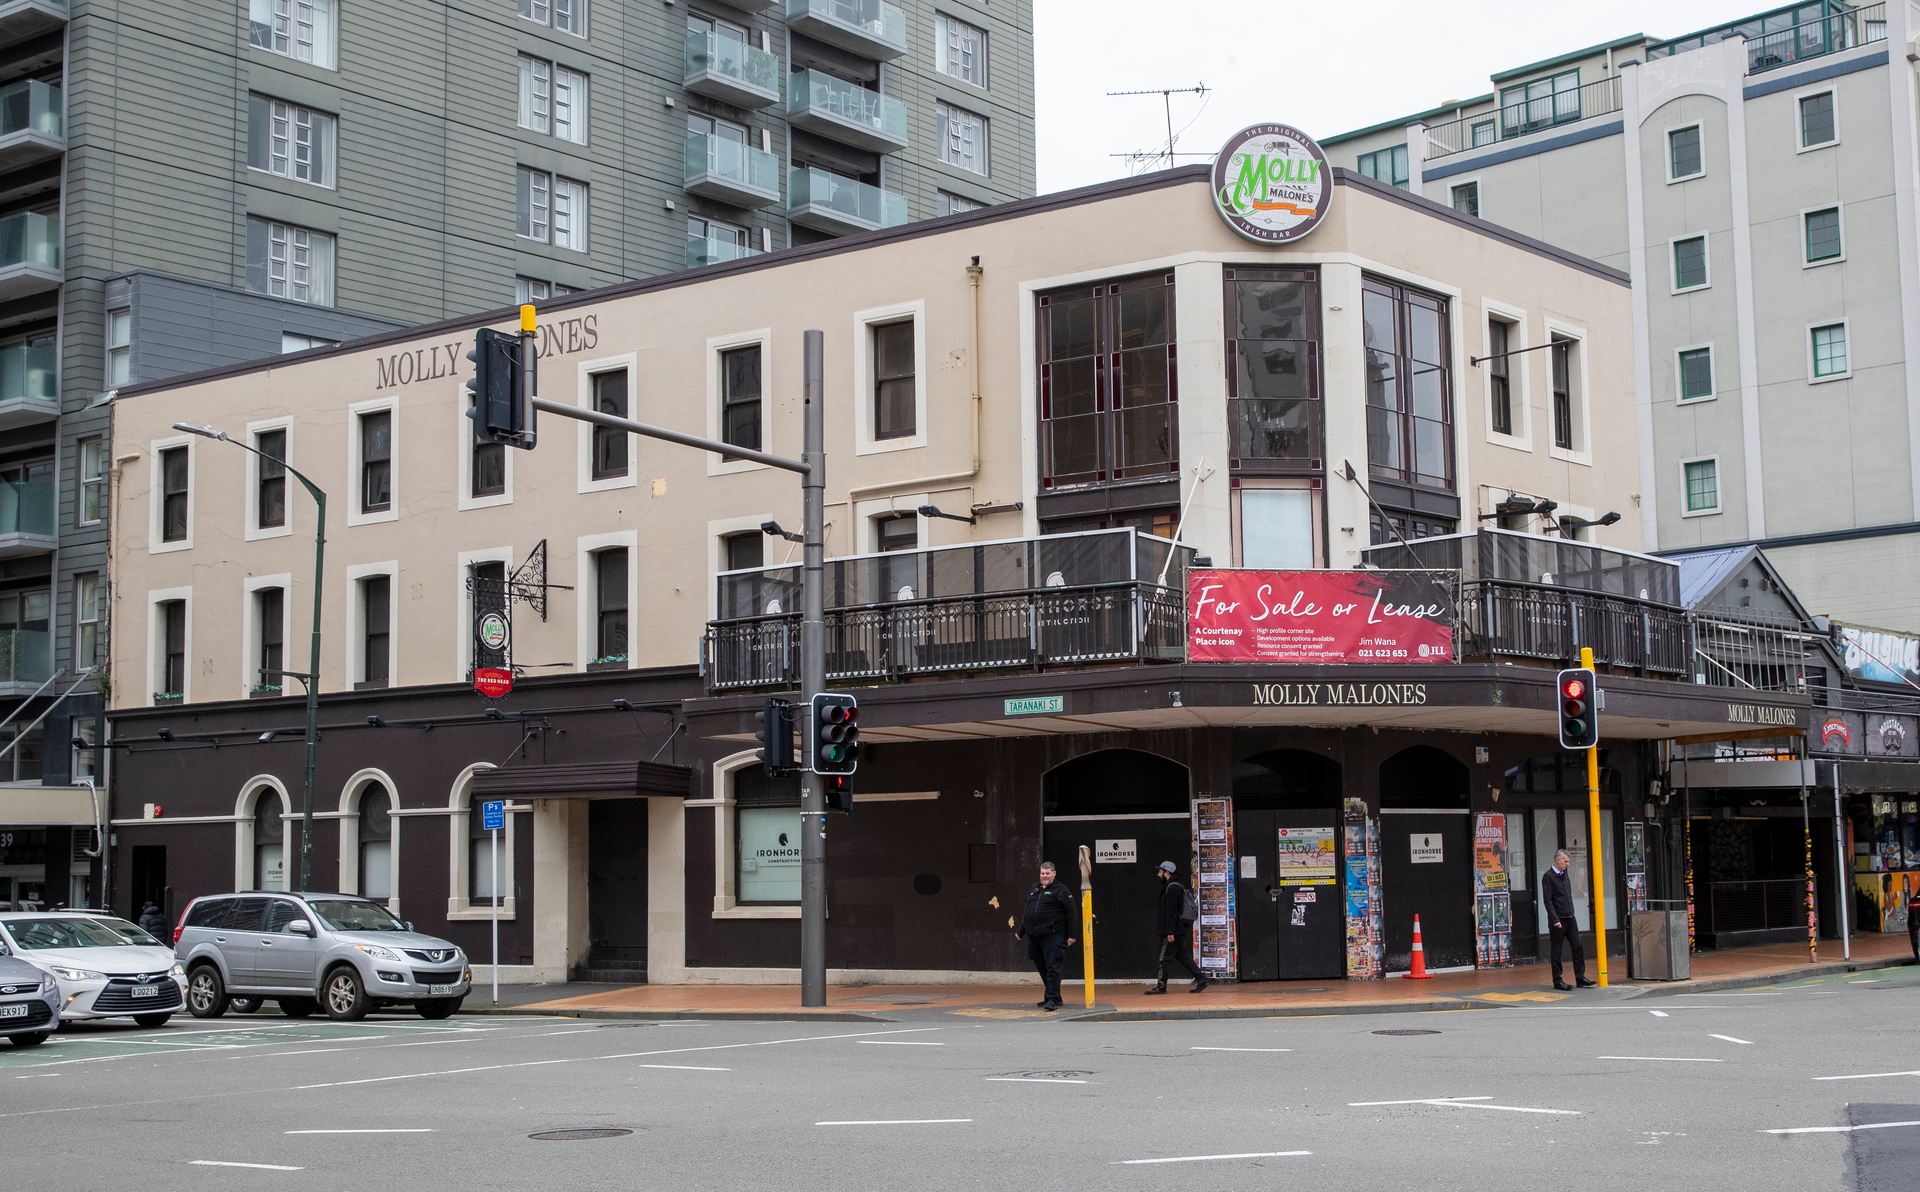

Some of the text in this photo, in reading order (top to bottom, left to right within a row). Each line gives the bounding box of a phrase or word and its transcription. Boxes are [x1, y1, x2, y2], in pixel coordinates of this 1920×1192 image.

[1245, 126, 1311, 148] THE ORIGINAL
[1222, 153, 1323, 214] MOLLY
[1269, 186, 1315, 203] MALONE'S
[1240, 221, 1291, 239] IRISH BAR
[376, 341, 463, 390] MOLLY
[1195, 584, 1241, 620] For
[1250, 583, 1323, 621] Sale
[1332, 603, 1358, 617] or
[1367, 588, 1446, 625] Lease
[1195, 627, 1243, 637] A Courtenay
[1256, 628, 1269, 636] High
[1269, 628, 1286, 636] profile
[1195, 638, 1235, 646] Place icon
[1256, 635, 1291, 643] Development
[1359, 638, 1397, 646] Jim Wana
[1358, 649, 1374, 657] 021
[1375, 649, 1391, 657] 623
[1430, 646, 1446, 655] JLL
[1252, 683, 1427, 705] MOLLY MALONES
[1009, 699, 1059, 712] TARANAKI ST
[1728, 704, 1796, 726] MOLLY MALONES
[1, 833, 13, 847] 39
[756, 849, 802, 857] IRONHOR
